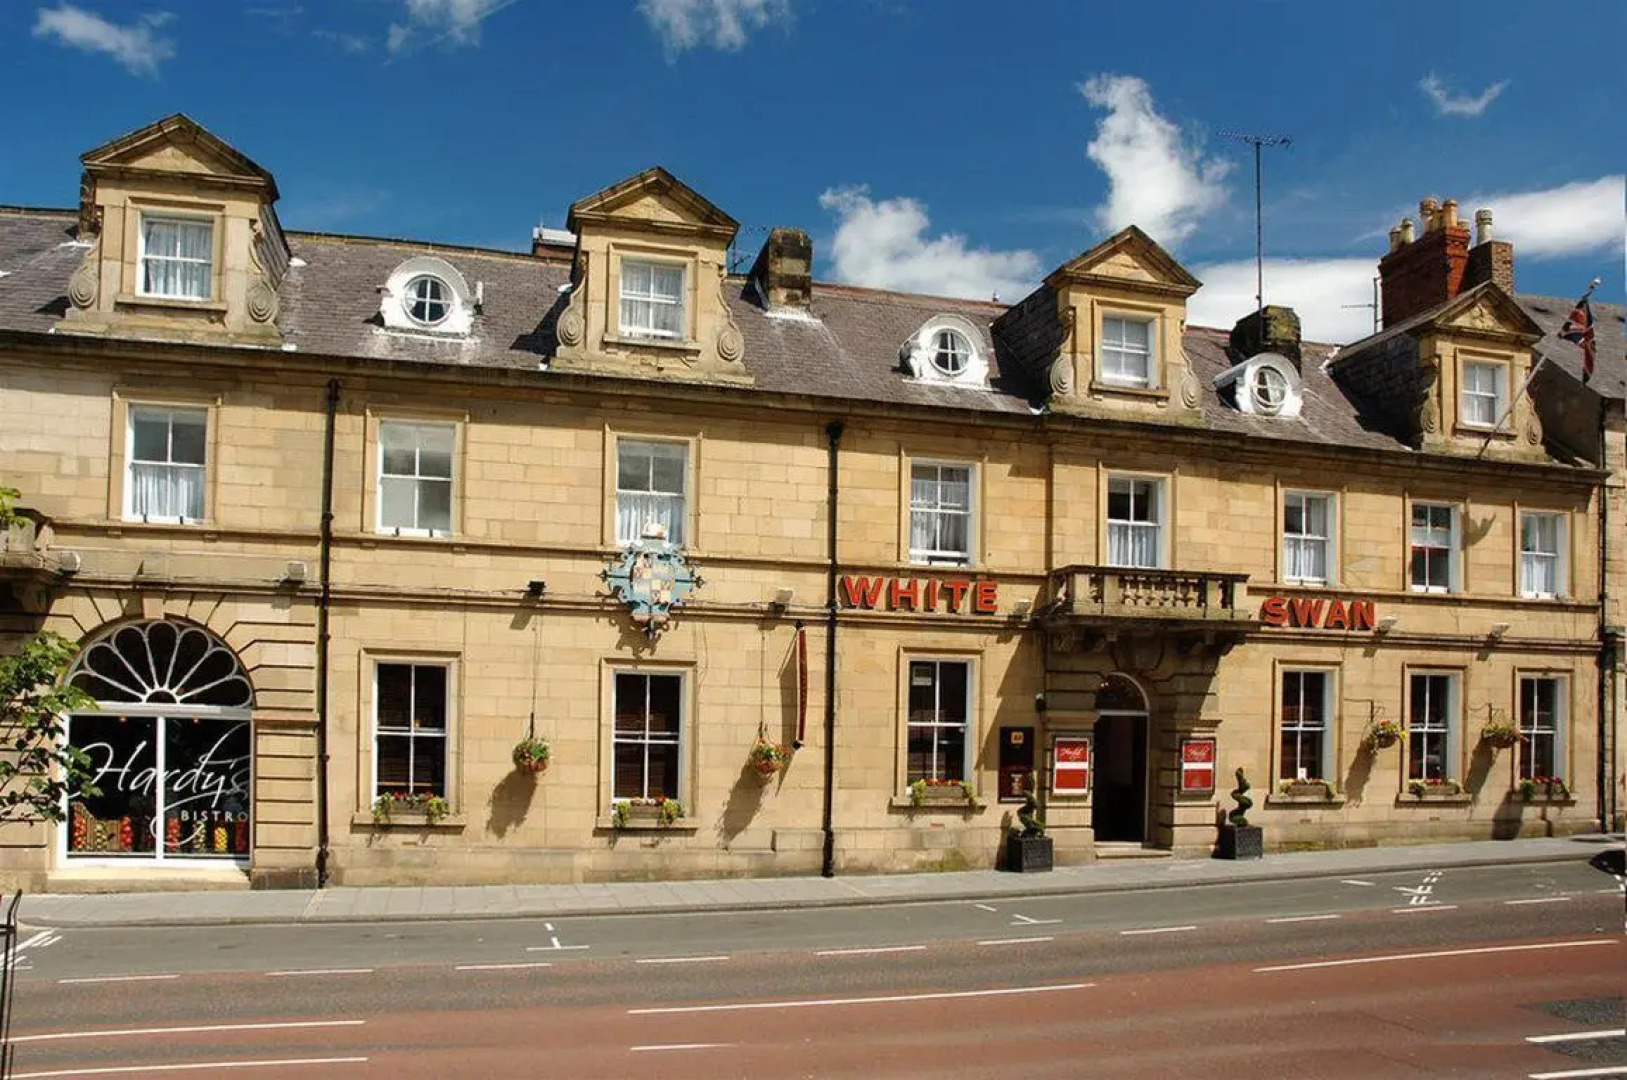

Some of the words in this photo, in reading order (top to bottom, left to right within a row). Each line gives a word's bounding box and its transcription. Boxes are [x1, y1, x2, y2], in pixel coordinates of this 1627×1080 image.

[843, 574, 998, 613] WHITE
[1261, 595, 1375, 630] SWAN
[70, 722, 251, 812] Hardy's
[180, 809, 249, 822] BISTRO
